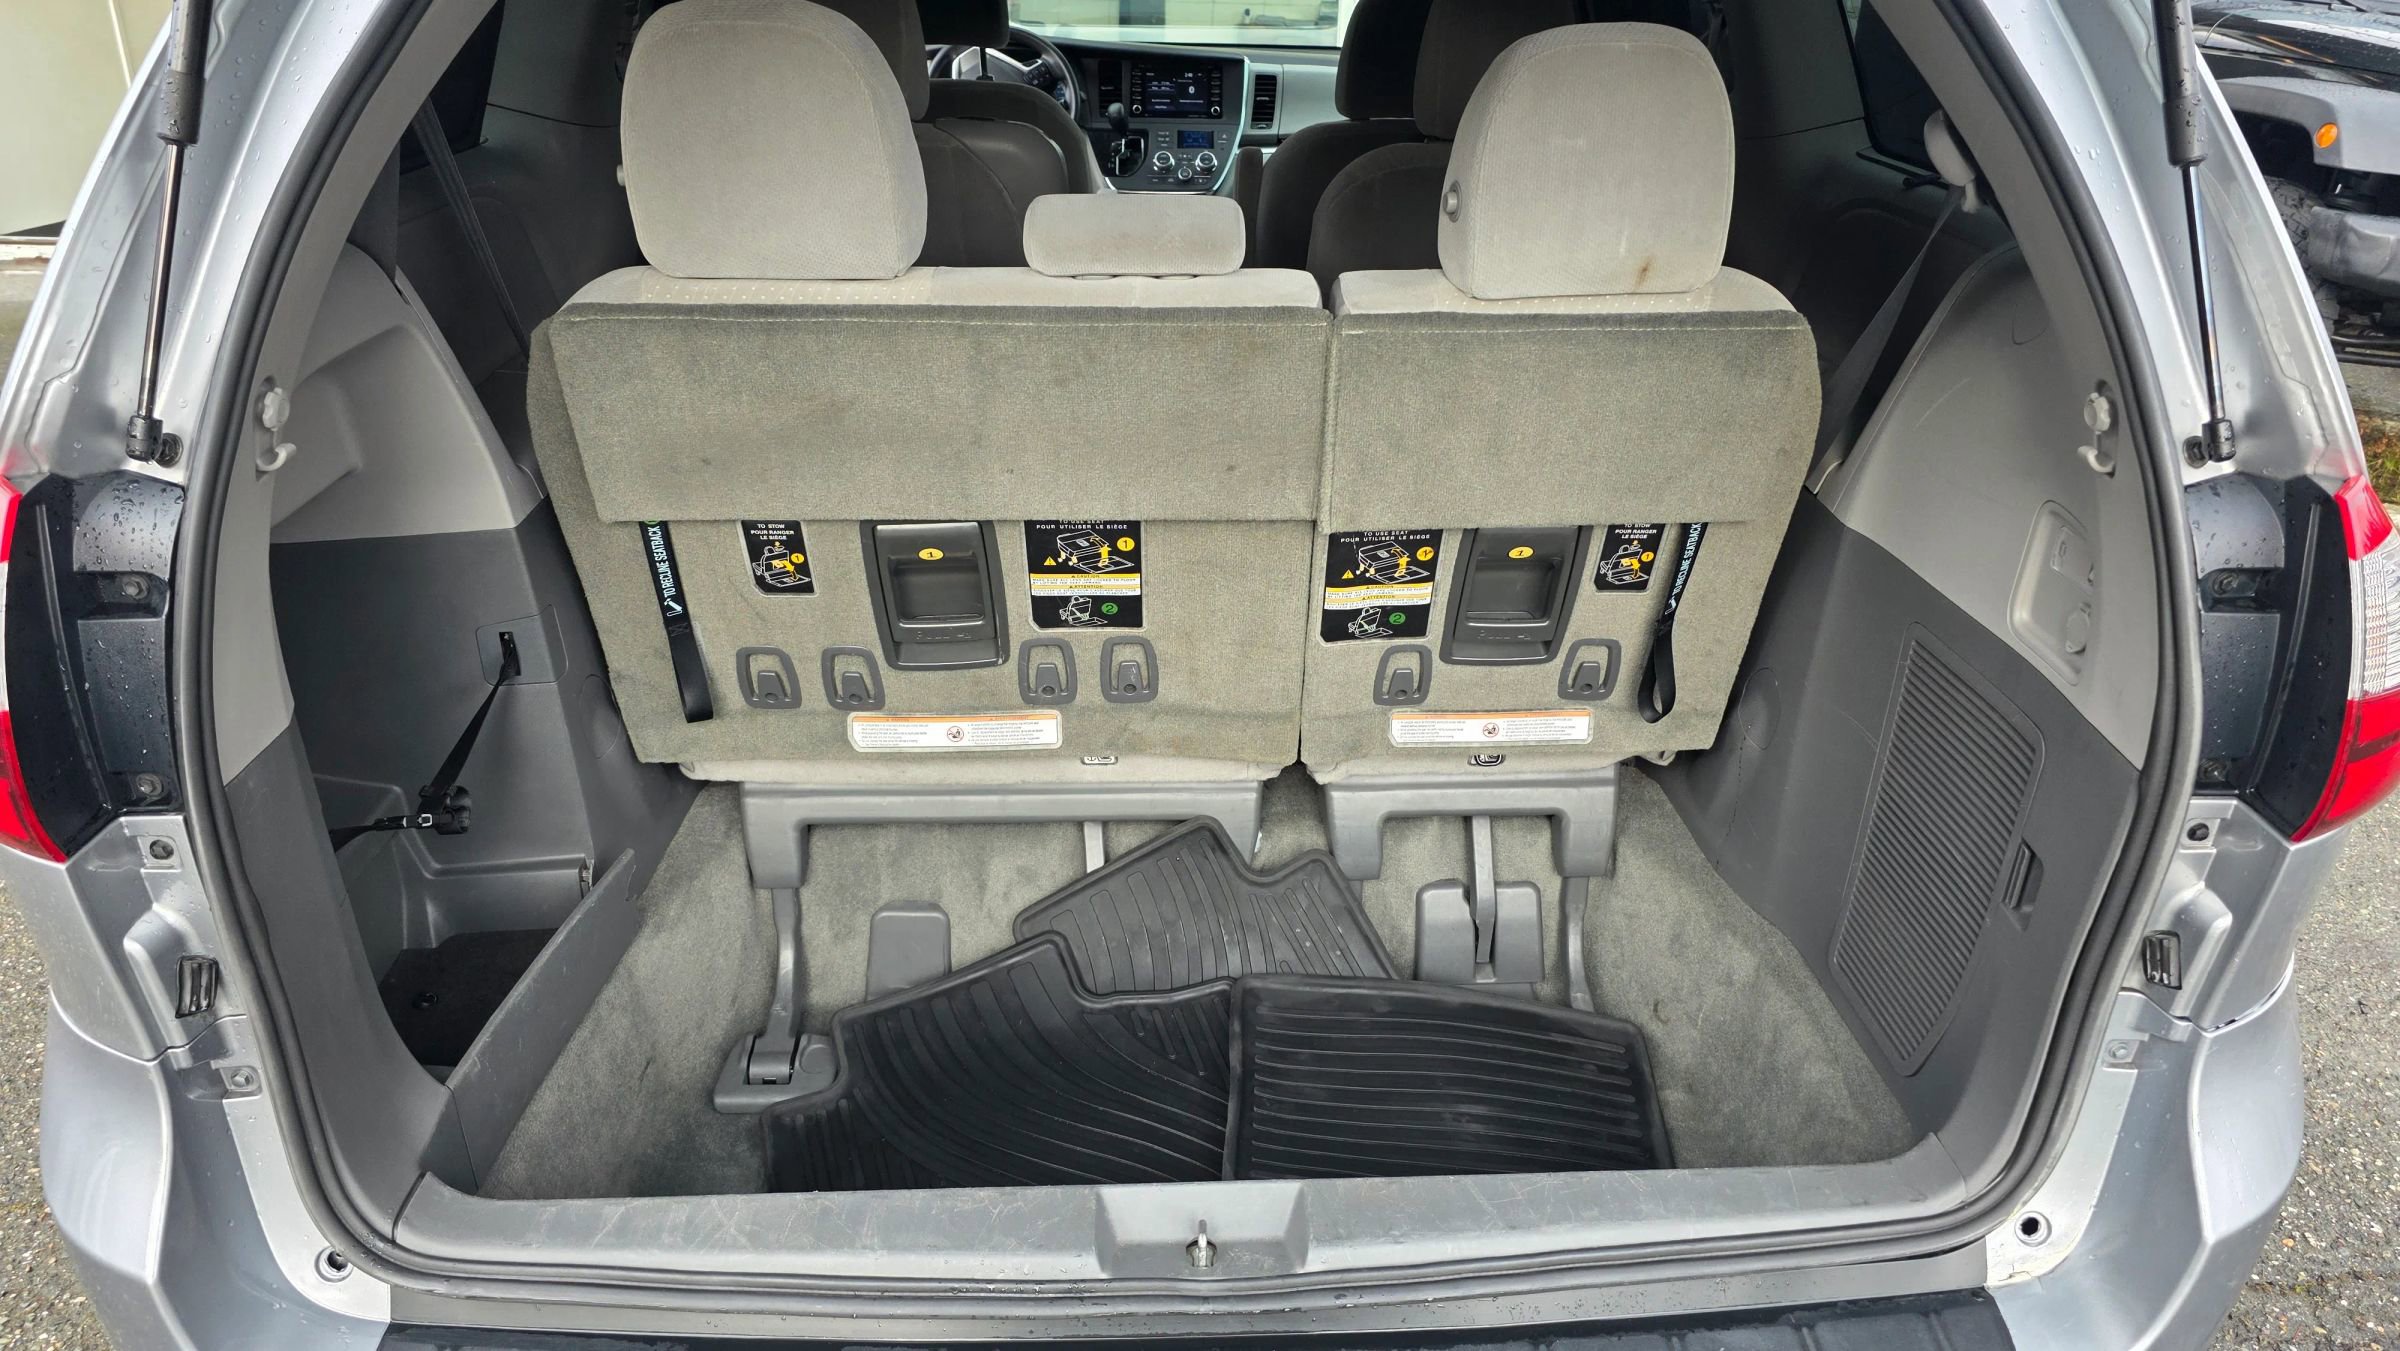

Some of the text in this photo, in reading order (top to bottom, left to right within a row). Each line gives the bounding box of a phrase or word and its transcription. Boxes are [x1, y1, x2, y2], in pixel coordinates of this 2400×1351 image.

[1683, 522, 1702, 558] SEATBACK
[647, 526, 676, 598] TO RECLINE SEATBACK
[1675, 558, 1692, 586] RECLINE
[1105, 605, 1114, 613] 2
[1393, 615, 1402, 623] 2
